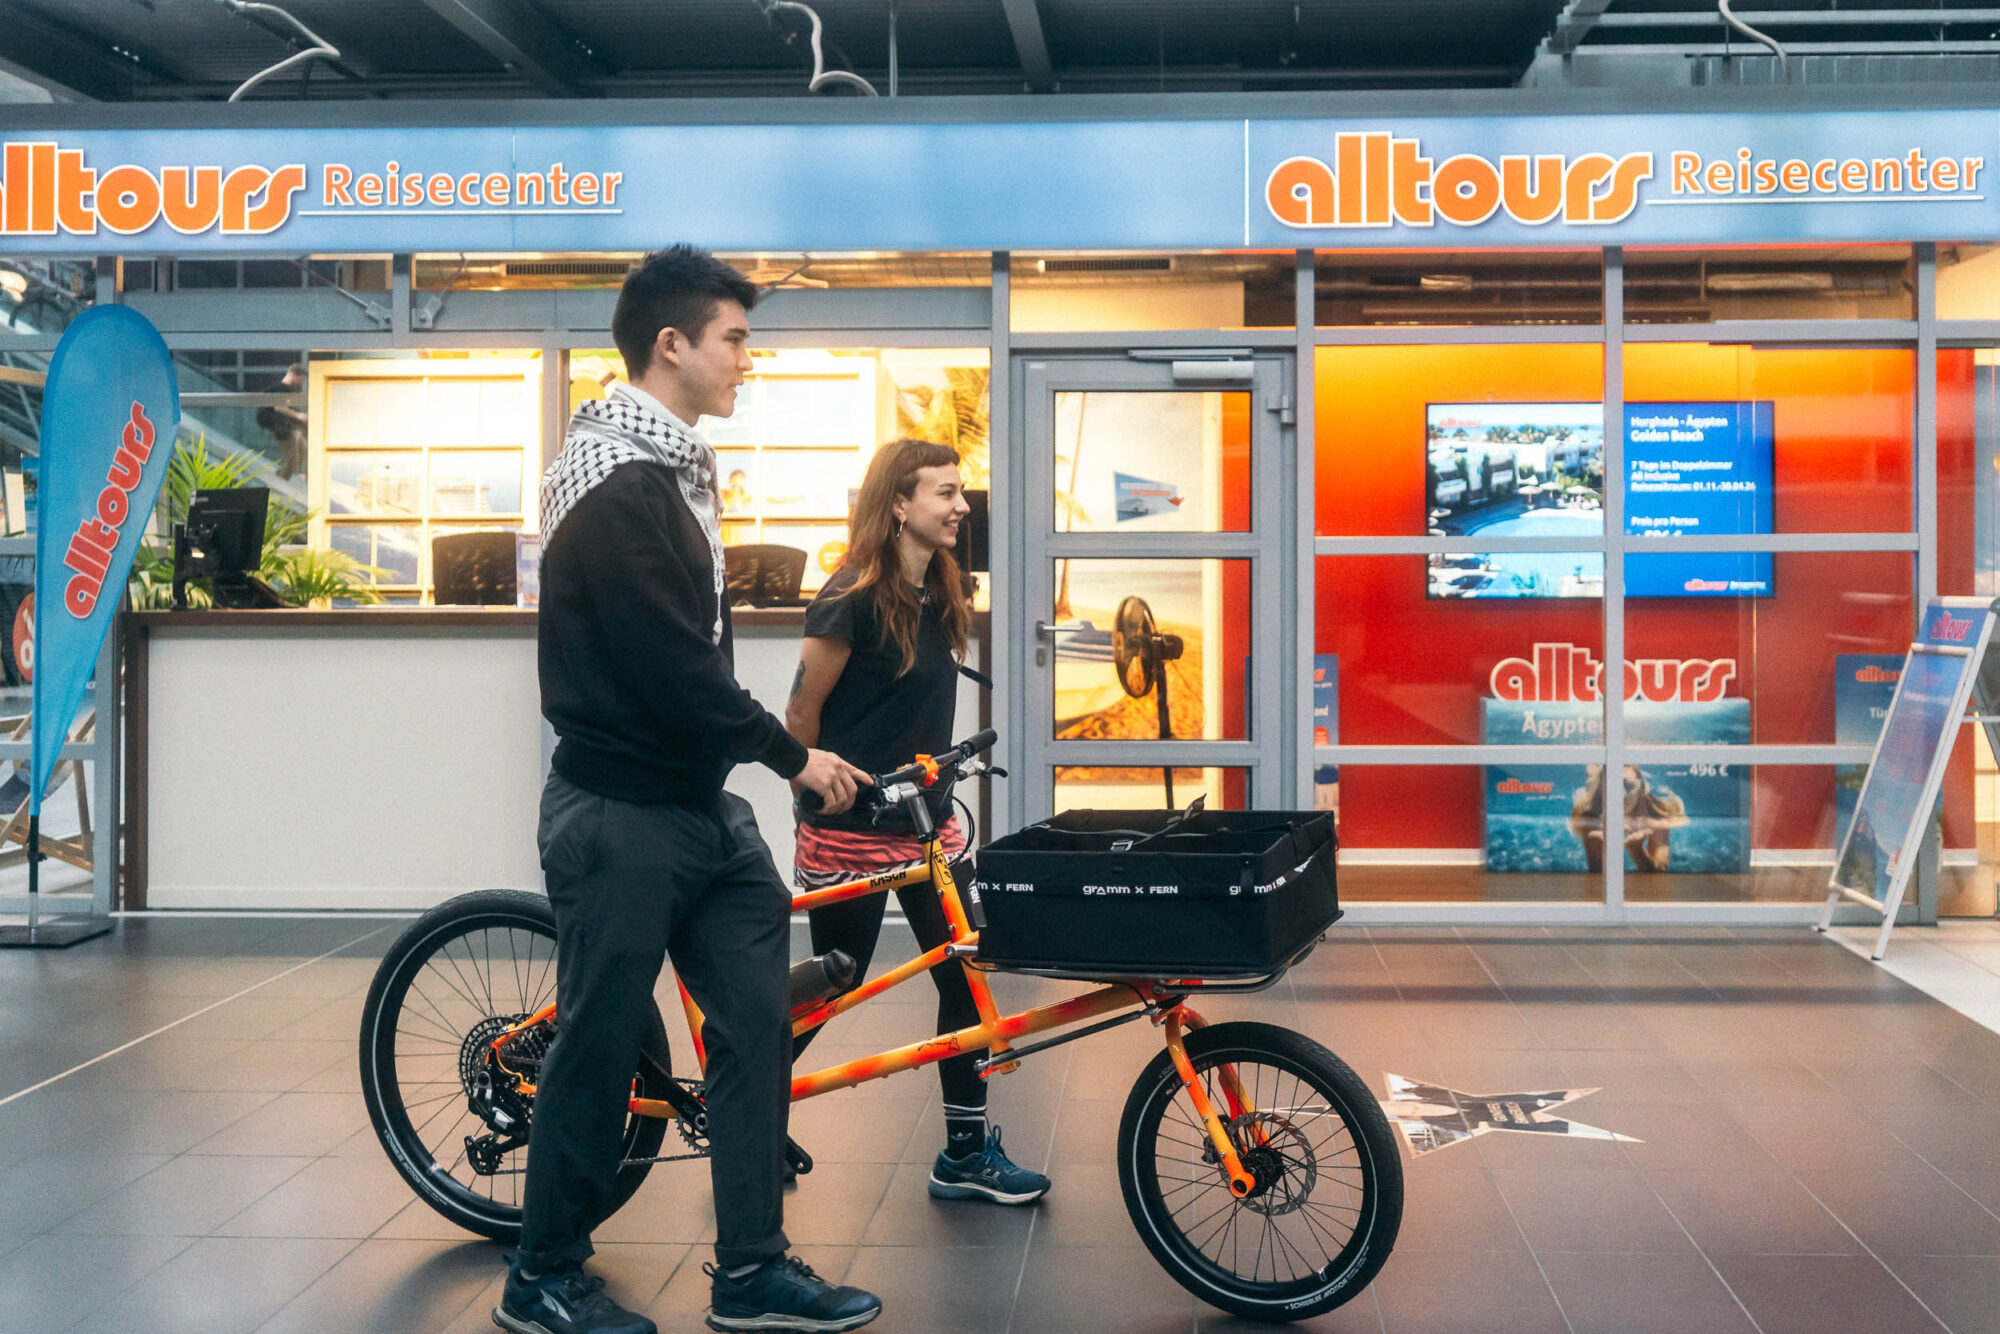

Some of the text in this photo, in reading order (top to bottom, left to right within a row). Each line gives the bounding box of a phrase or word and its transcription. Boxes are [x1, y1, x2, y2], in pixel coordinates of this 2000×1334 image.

[0, 141, 623, 236] lltours Reisecenter
[1265, 130, 1985, 230] alltours Reisecenter
[63, 400, 156, 619] alltours
[1522, 710, 1603, 738] Ägypte
[1005, 883, 1034, 892] FERN
[1149, 885, 1179, 894] FERN
